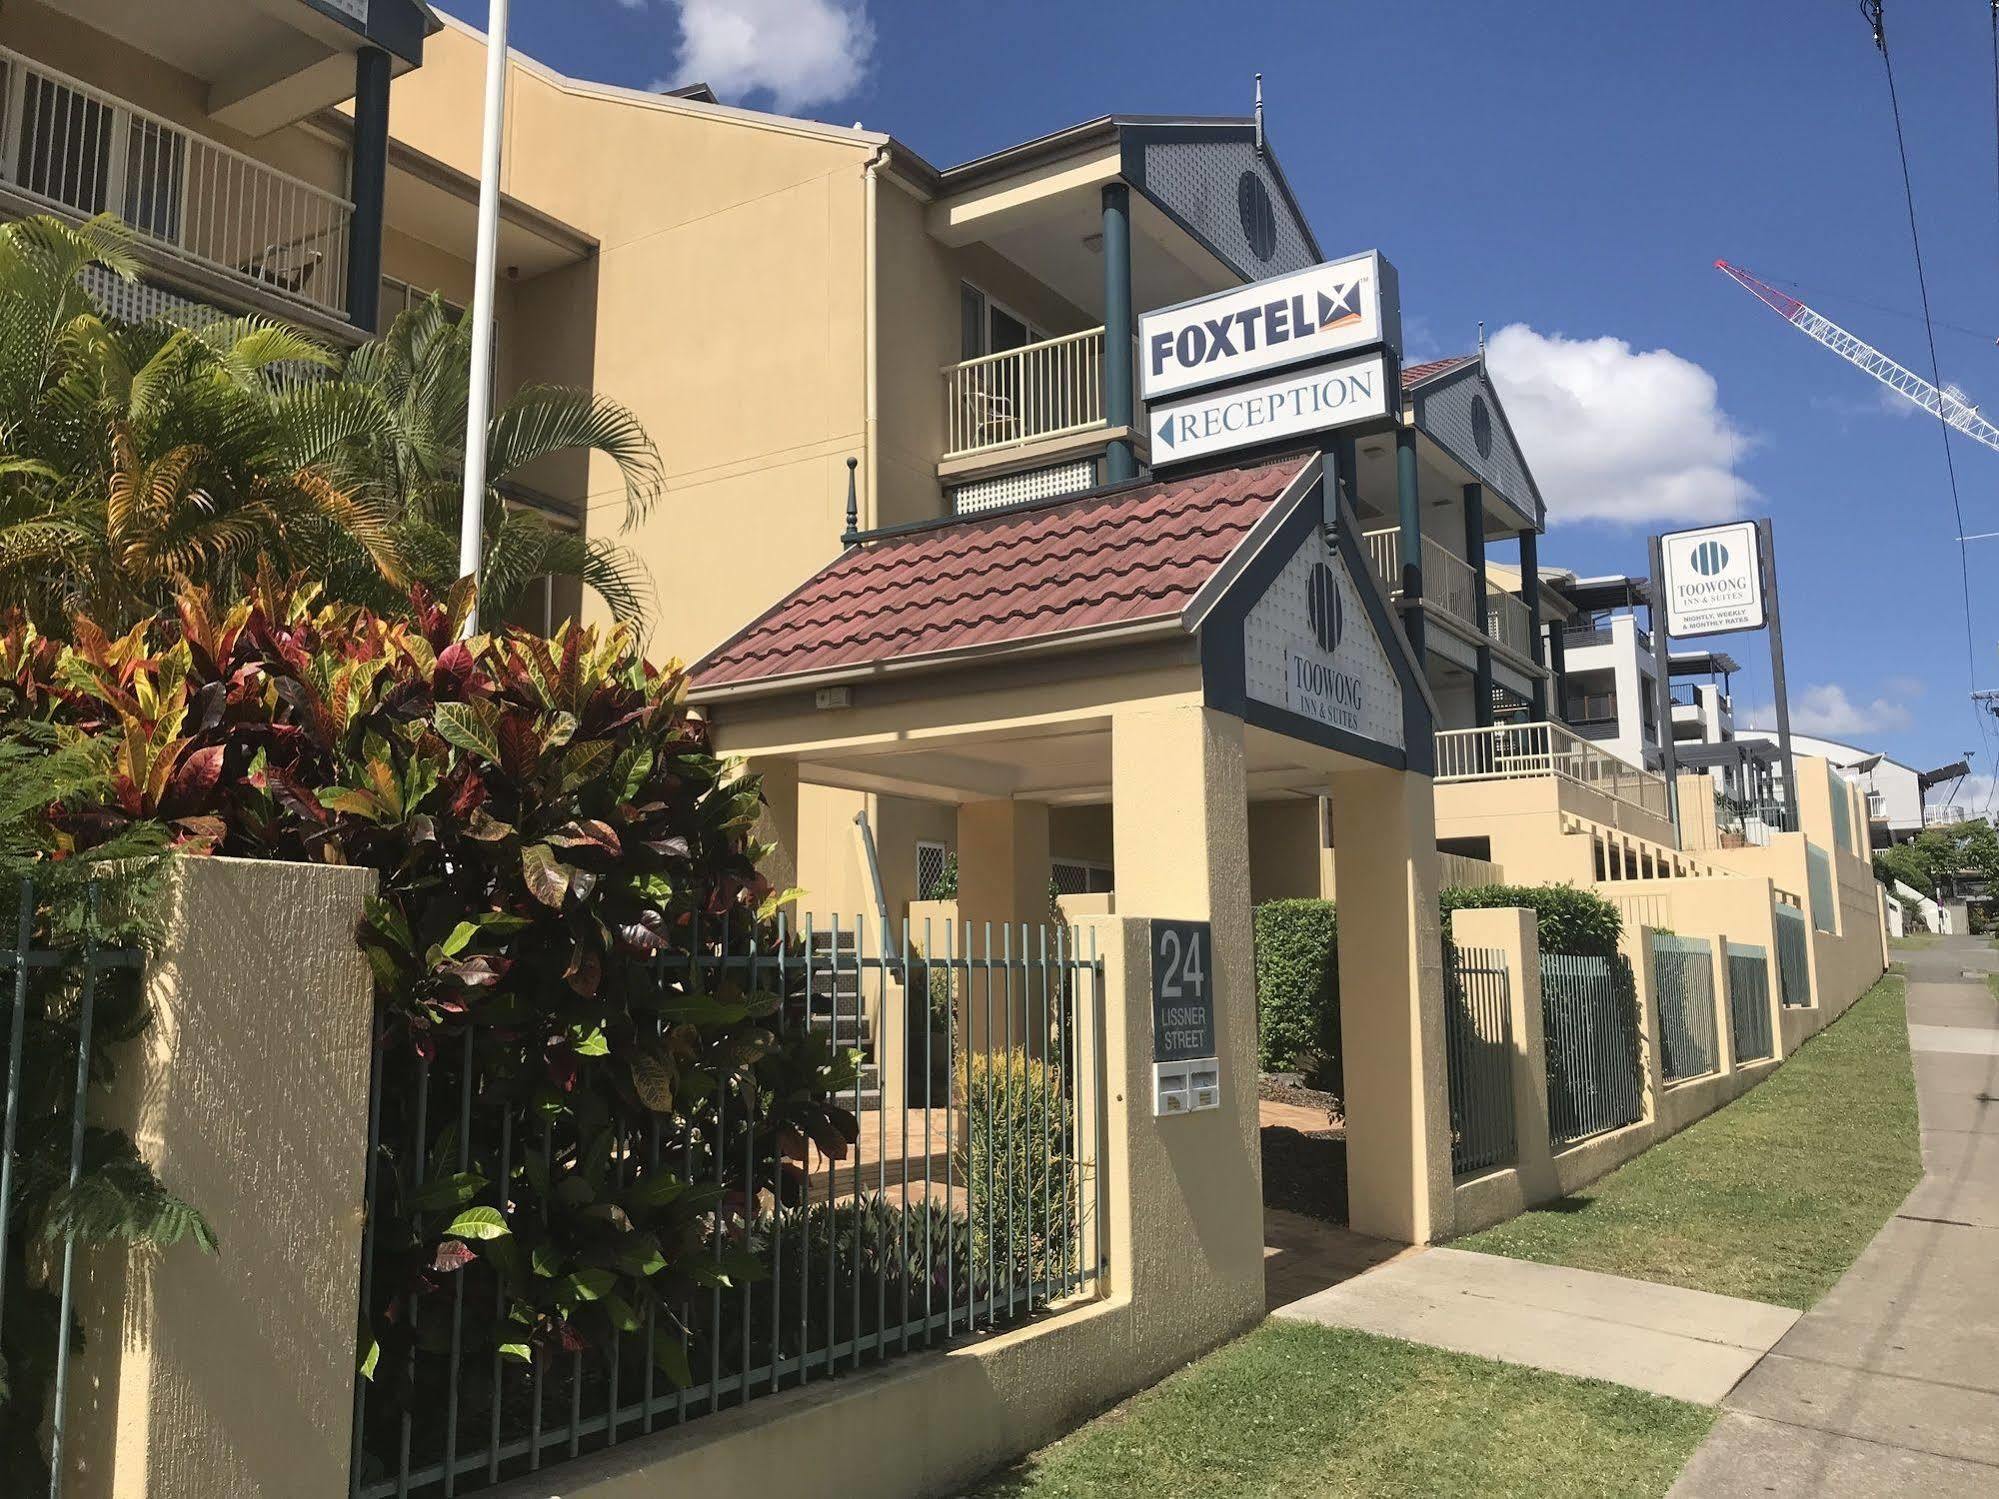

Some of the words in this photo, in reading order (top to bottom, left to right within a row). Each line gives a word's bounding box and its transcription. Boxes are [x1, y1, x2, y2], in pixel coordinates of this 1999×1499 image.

[1151, 294, 1315, 376] FOXTEL
[1180, 371, 1374, 443] RECEPTION
[1677, 577, 1747, 598] TOOWONG
[1684, 598, 1699, 606] INN
[1711, 592, 1743, 602] SUITES
[1690, 620, 1723, 629] MONTHLY
[1725, 616, 1749, 625] RATES
[1716, 609, 1746, 619] WEEKLY
[1294, 656, 1362, 711] TOOWONG
[1300, 695, 1317, 716] INN
[1319, 703, 1326, 719] &
[1328, 705, 1358, 730] SUITES
[1160, 929, 1204, 998] 24
[1161, 1006, 1206, 1026] LISSNER
[1164, 1030, 1204, 1050] STREET
